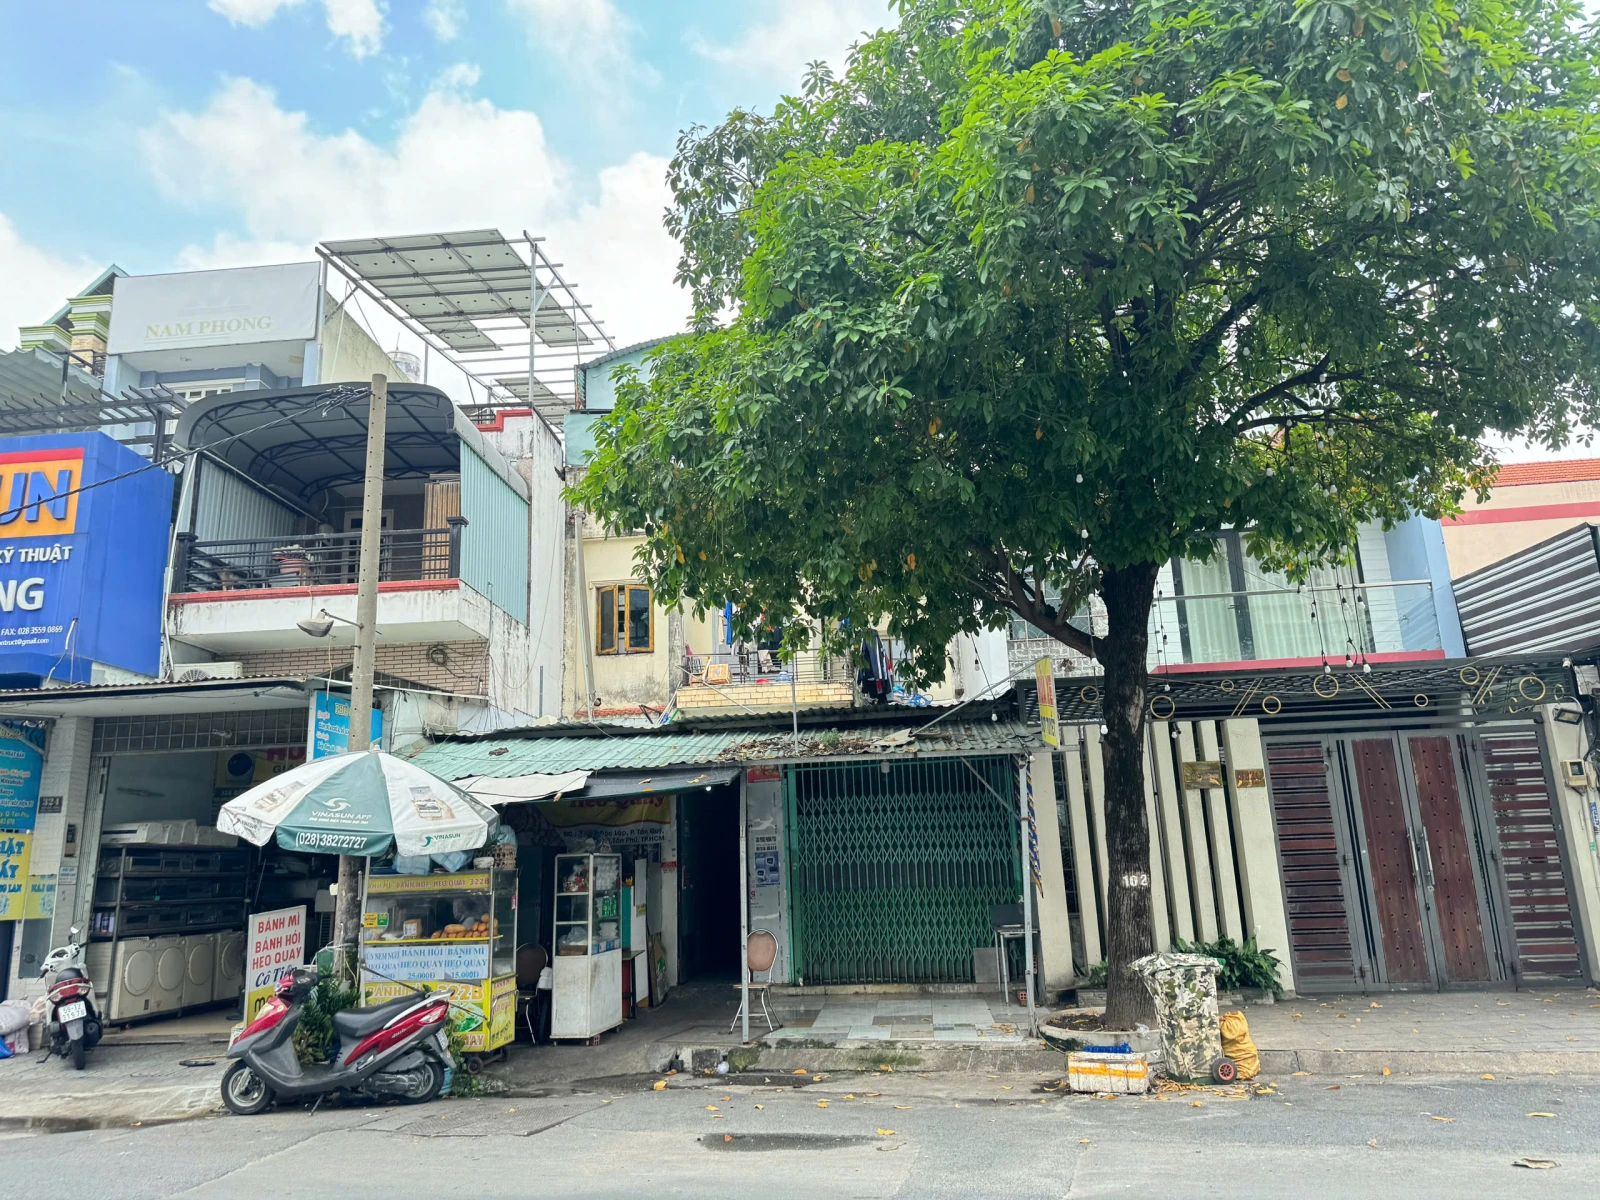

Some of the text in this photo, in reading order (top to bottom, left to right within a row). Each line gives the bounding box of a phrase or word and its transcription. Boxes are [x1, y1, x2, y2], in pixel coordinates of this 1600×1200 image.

[145, 316, 272, 338] NAM PHONG
[18, 543, 73, 564] THUẬT
[18, 627, 30, 635] 028
[312, 811, 354, 819] VINASUN
[434, 833, 461, 841] VINASUN
[258, 912, 300, 934] BÁNH MÌ
[255, 930, 301, 953] BÁNH HỎI
[402, 947, 426, 957] BÁNH
[448, 946, 471, 955] BÁNH
[252, 947, 302, 970] HEO QUAY
[464, 959, 487, 967] QUAY
[401, 960, 443, 970] HEO QUAY
[256, 966, 297, 987] Cô Ti
